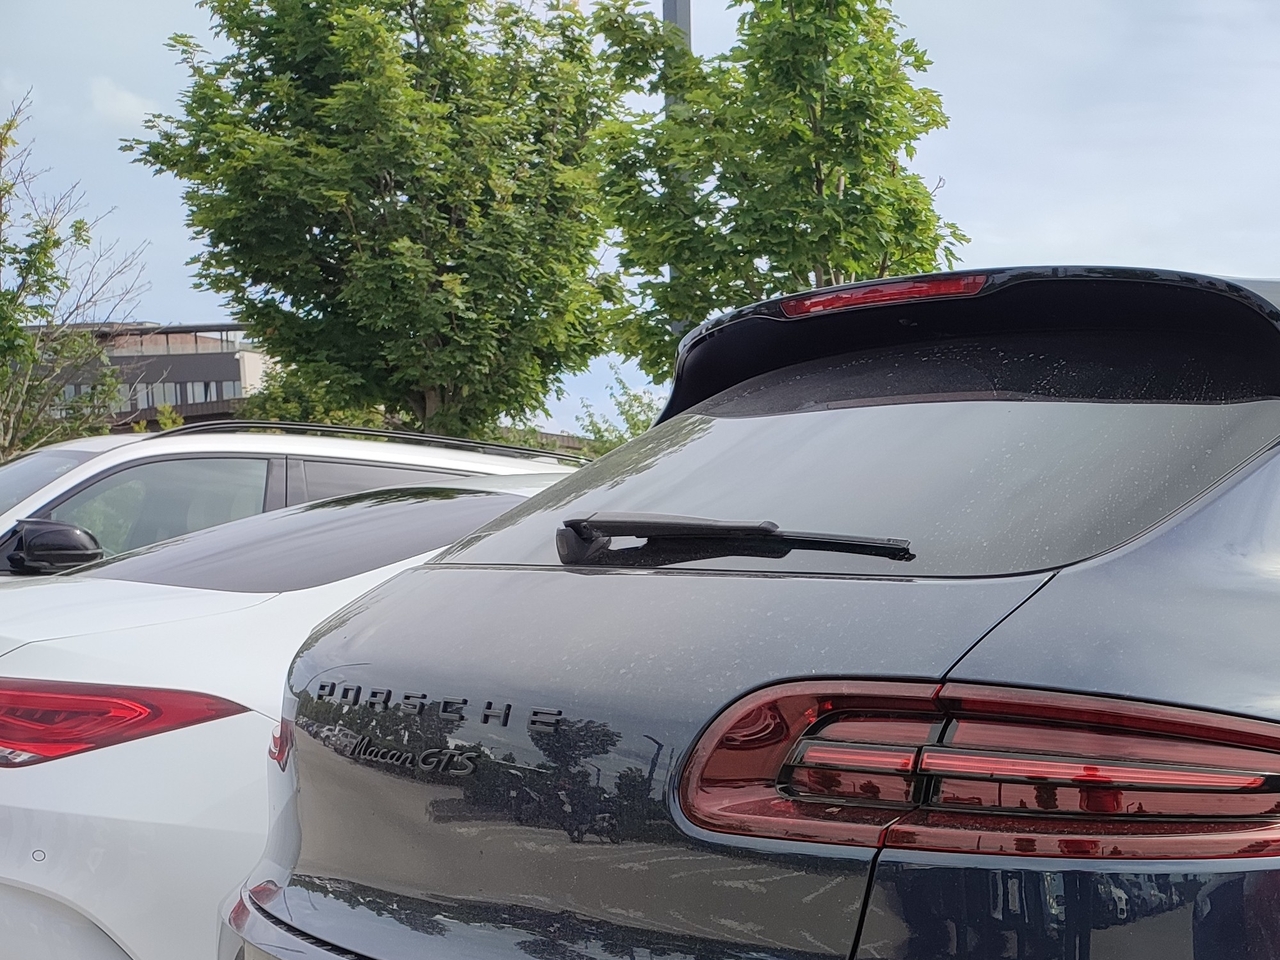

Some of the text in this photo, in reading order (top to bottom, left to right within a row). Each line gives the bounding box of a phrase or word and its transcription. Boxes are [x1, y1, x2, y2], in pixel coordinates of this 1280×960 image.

[317, 681, 563, 733] PORSCHE
[349, 735, 479, 777] Macan GTS
